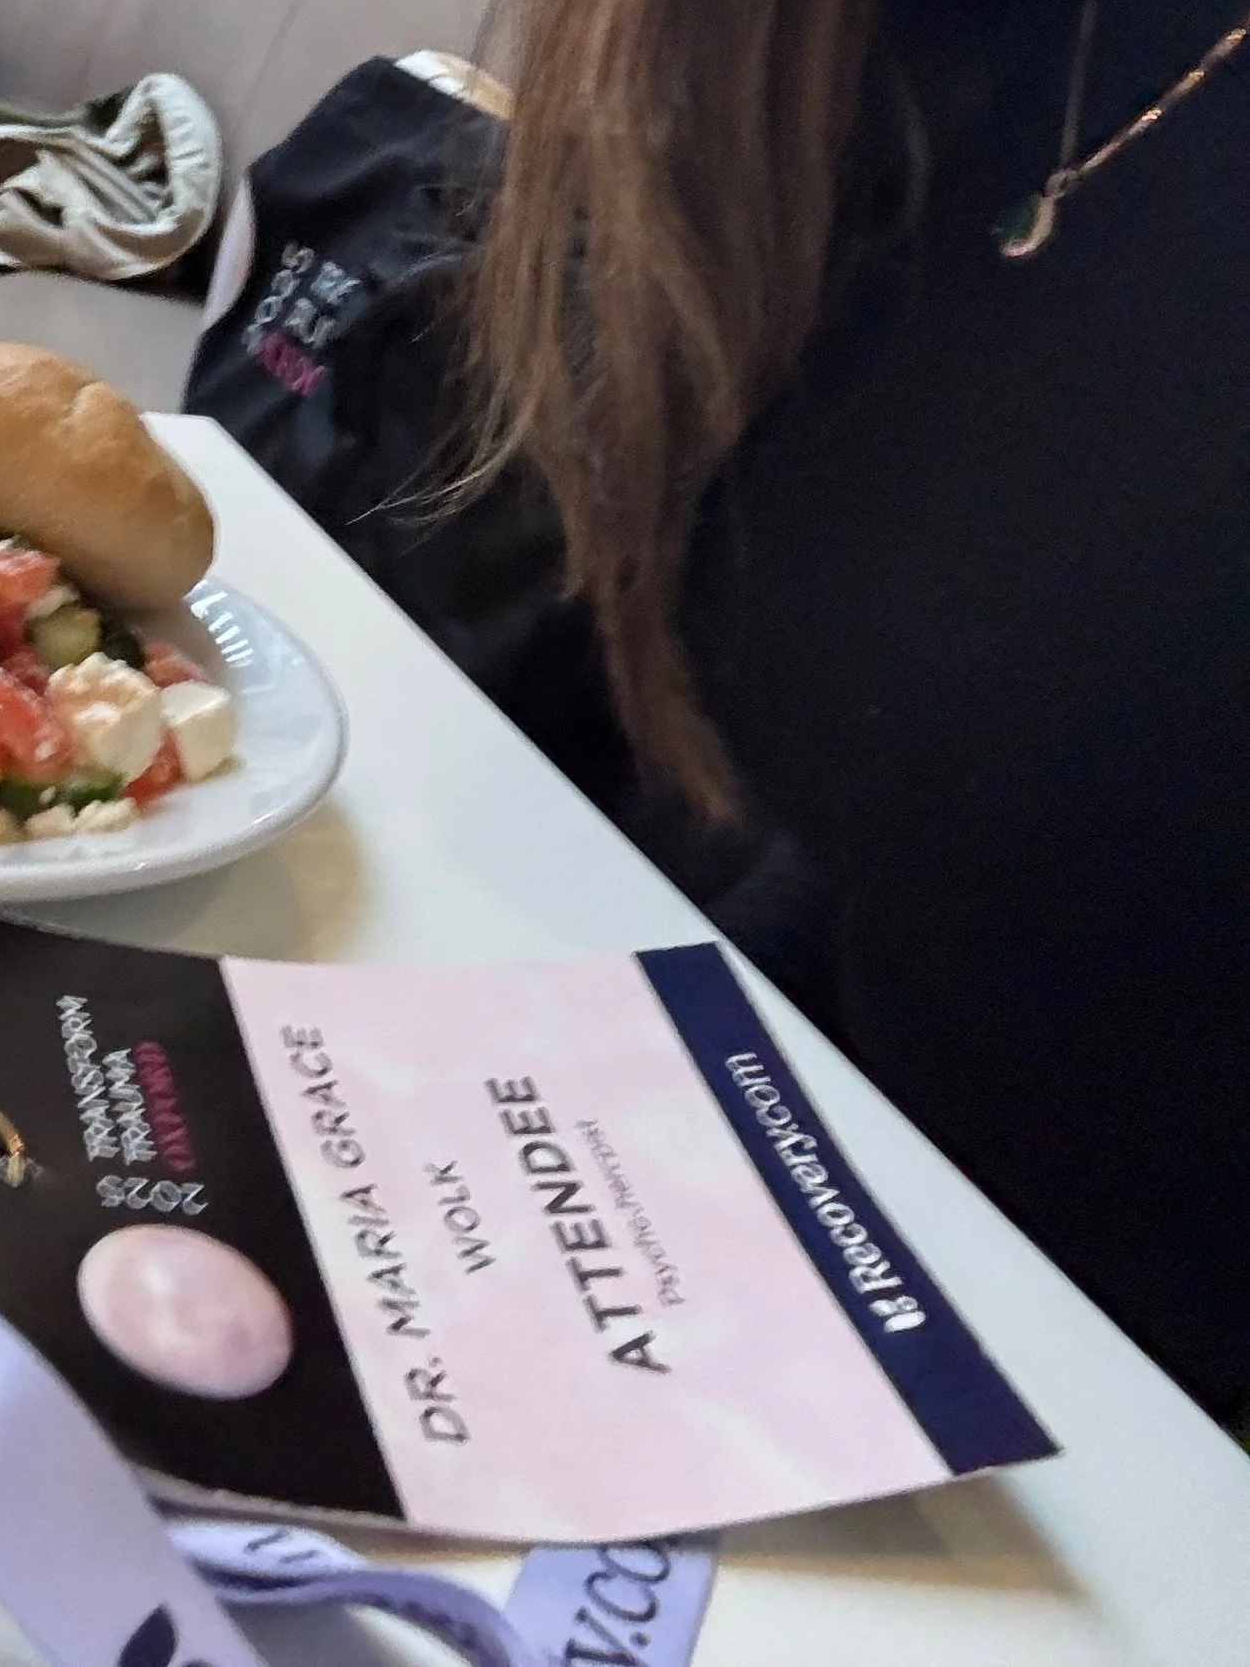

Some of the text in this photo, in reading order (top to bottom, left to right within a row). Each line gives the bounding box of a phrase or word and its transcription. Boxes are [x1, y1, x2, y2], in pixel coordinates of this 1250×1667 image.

[95, 1175, 209, 1216] 2025
[280, 1024, 470, 1445] DR. MARIA GRACE
[423, 1158, 496, 1275] WOLK
[482, 1074, 672, 1375] ATTENDEE
